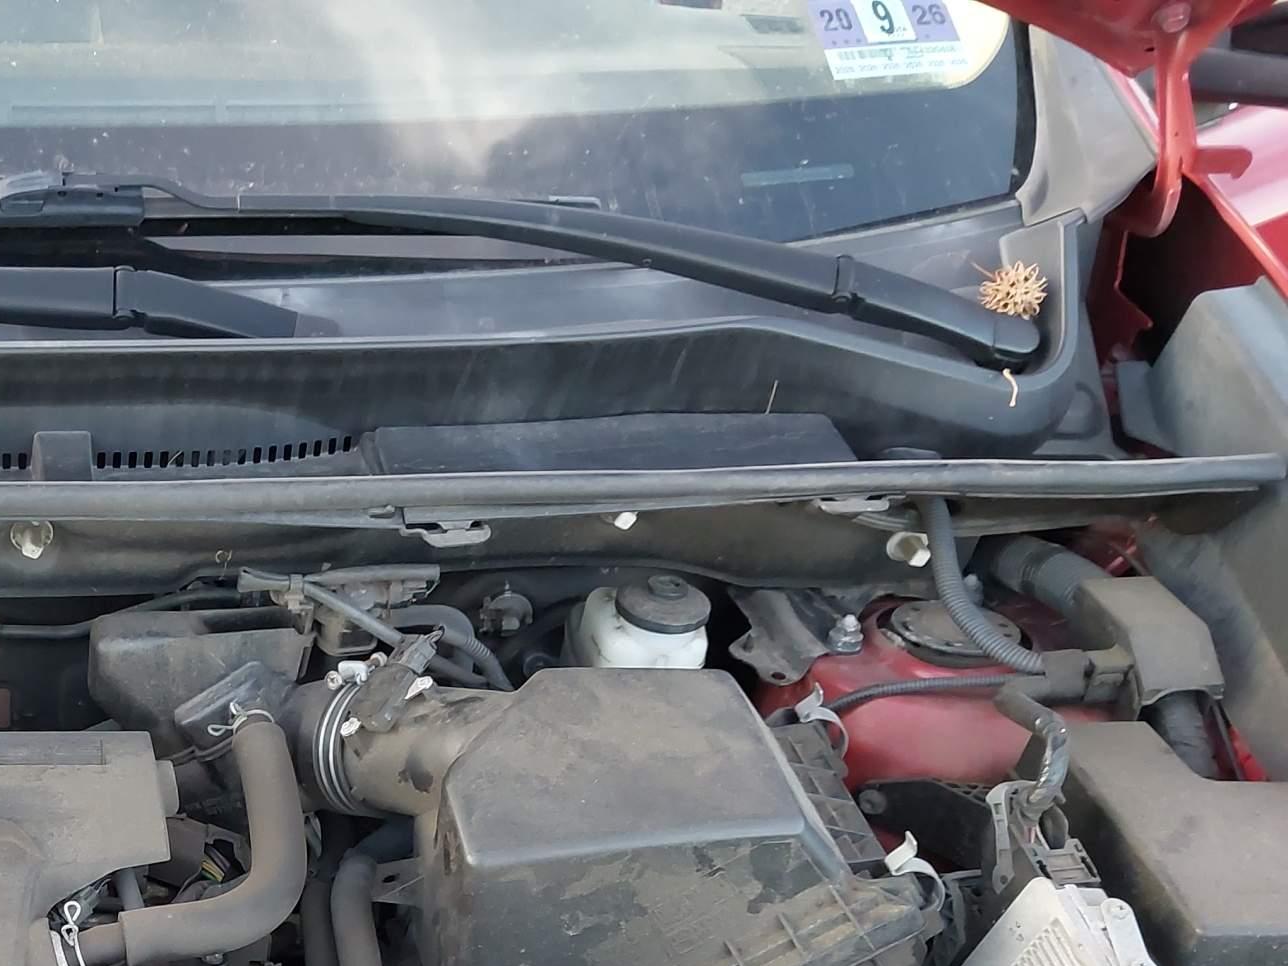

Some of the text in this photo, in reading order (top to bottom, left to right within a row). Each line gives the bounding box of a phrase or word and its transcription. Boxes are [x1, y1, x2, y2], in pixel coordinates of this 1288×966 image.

[819, 0, 946, 34] 20 9 26
